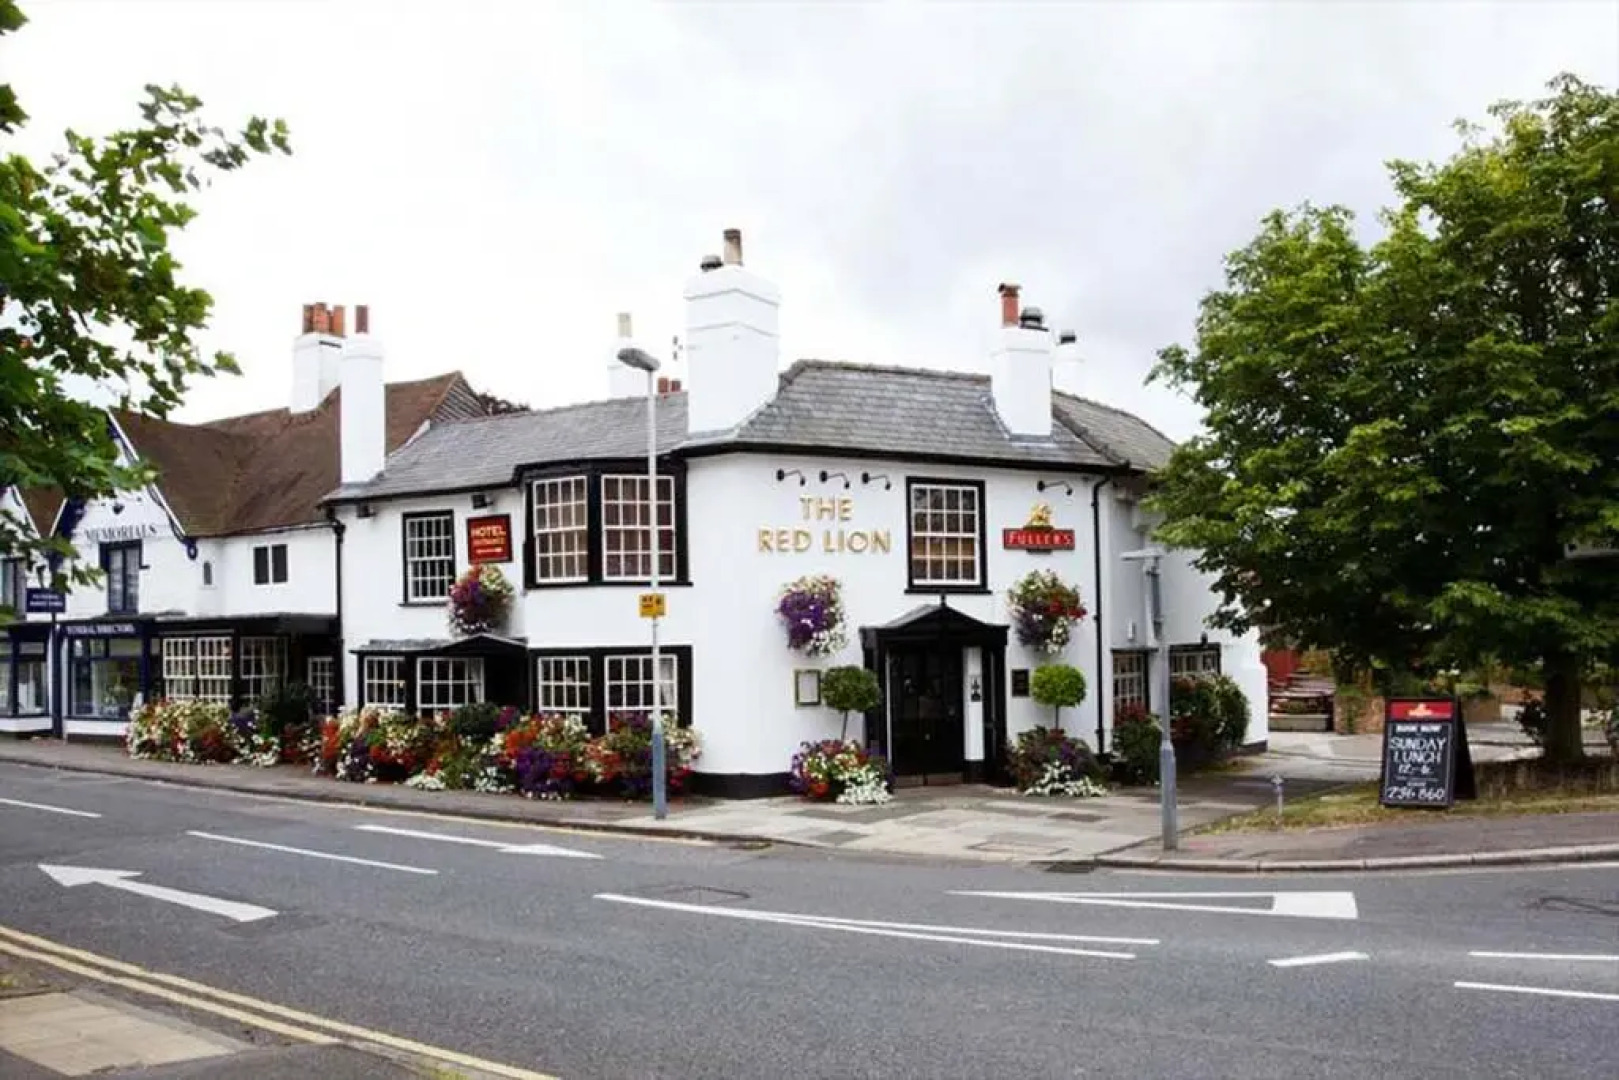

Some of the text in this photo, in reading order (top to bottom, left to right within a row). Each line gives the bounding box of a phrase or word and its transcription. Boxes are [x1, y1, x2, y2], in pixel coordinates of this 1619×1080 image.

[800, 496, 853, 521] THE
[470, 525, 507, 538] HOTEL
[758, 528, 891, 553] RED LION
[1390, 736, 1446, 750] SUNDAY
[1393, 751, 1441, 763] LUNCH
